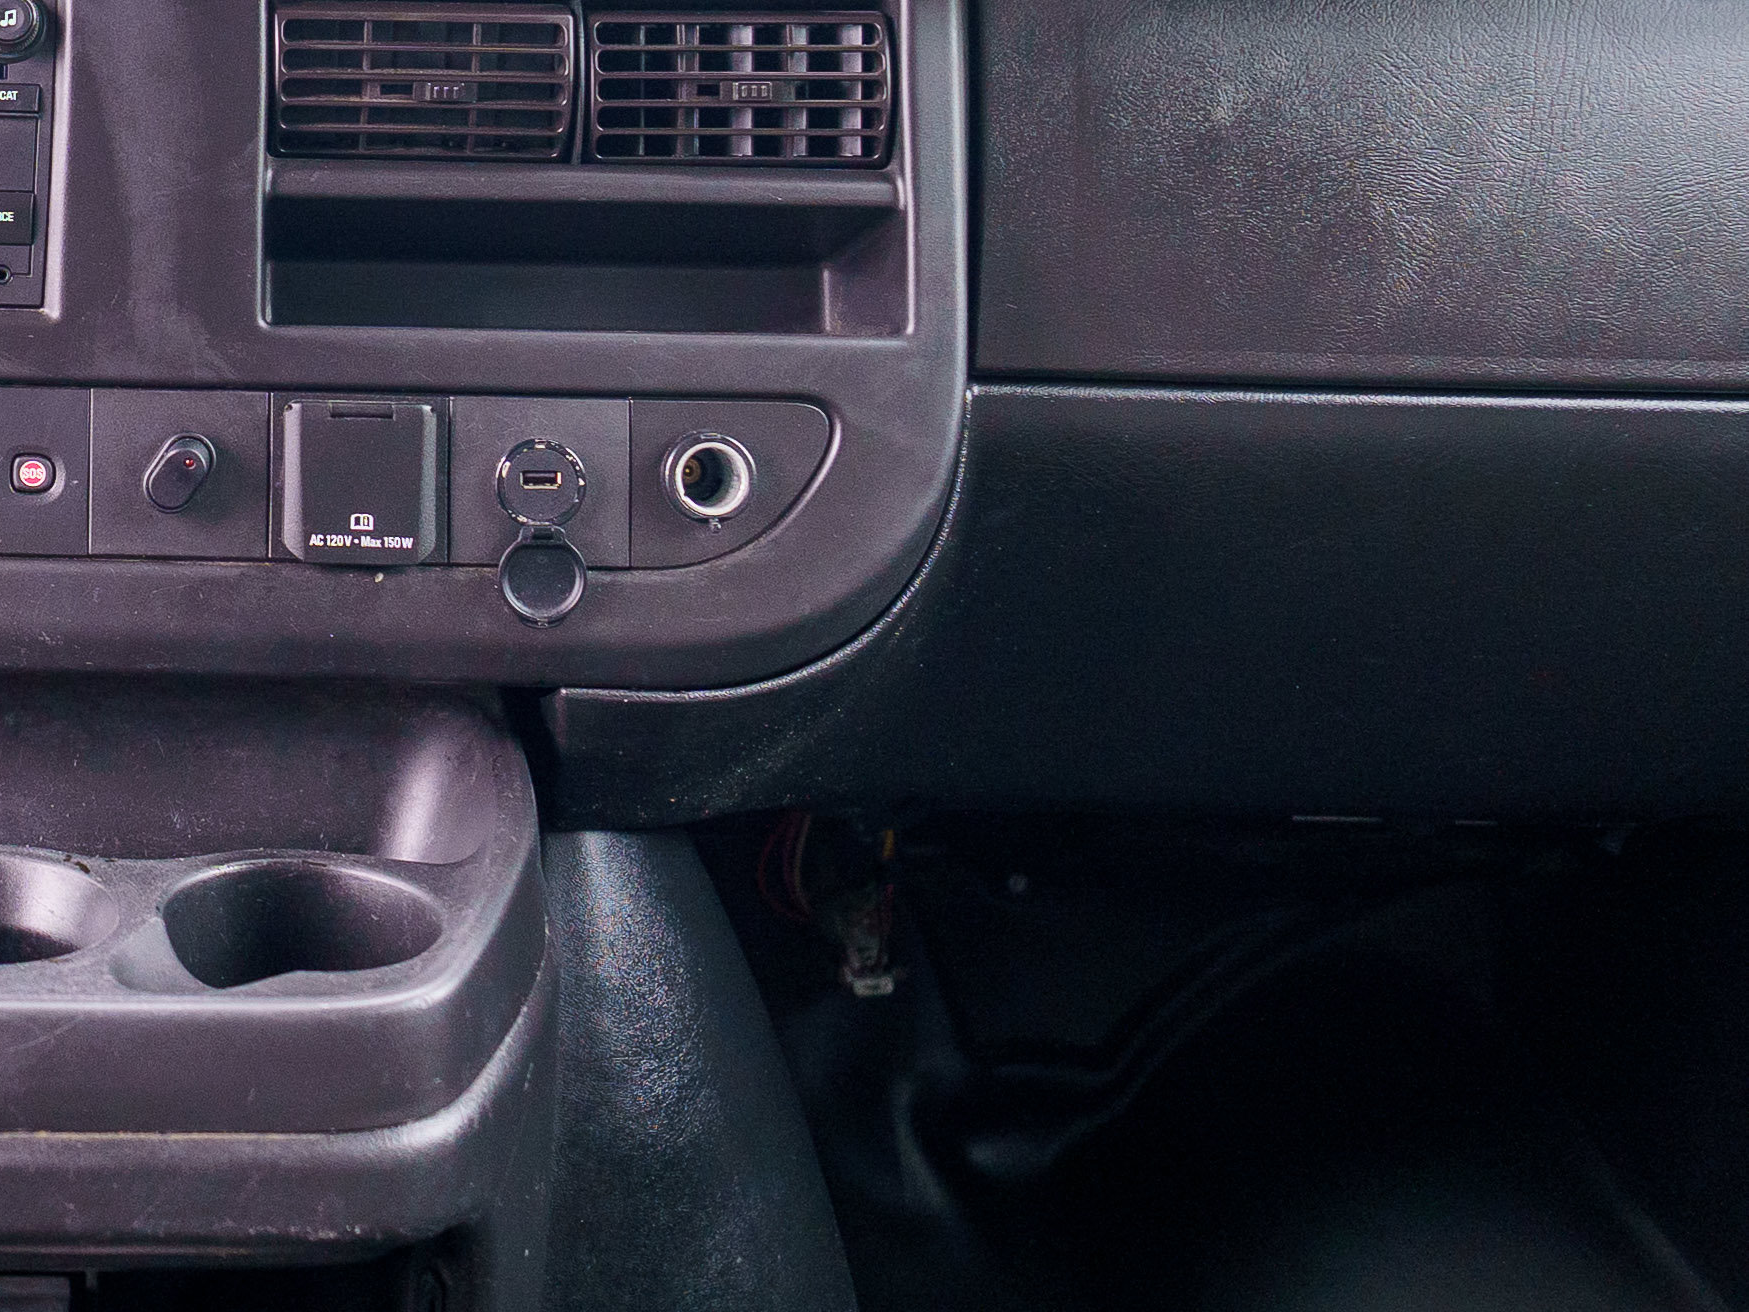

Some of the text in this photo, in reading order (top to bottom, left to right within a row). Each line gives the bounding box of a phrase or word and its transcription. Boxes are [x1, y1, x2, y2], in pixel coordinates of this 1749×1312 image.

[0, 90, 19, 101] CAT
[22, 467, 44, 479] SOS
[309, 534, 324, 546] AC
[360, 535, 382, 548] Max
